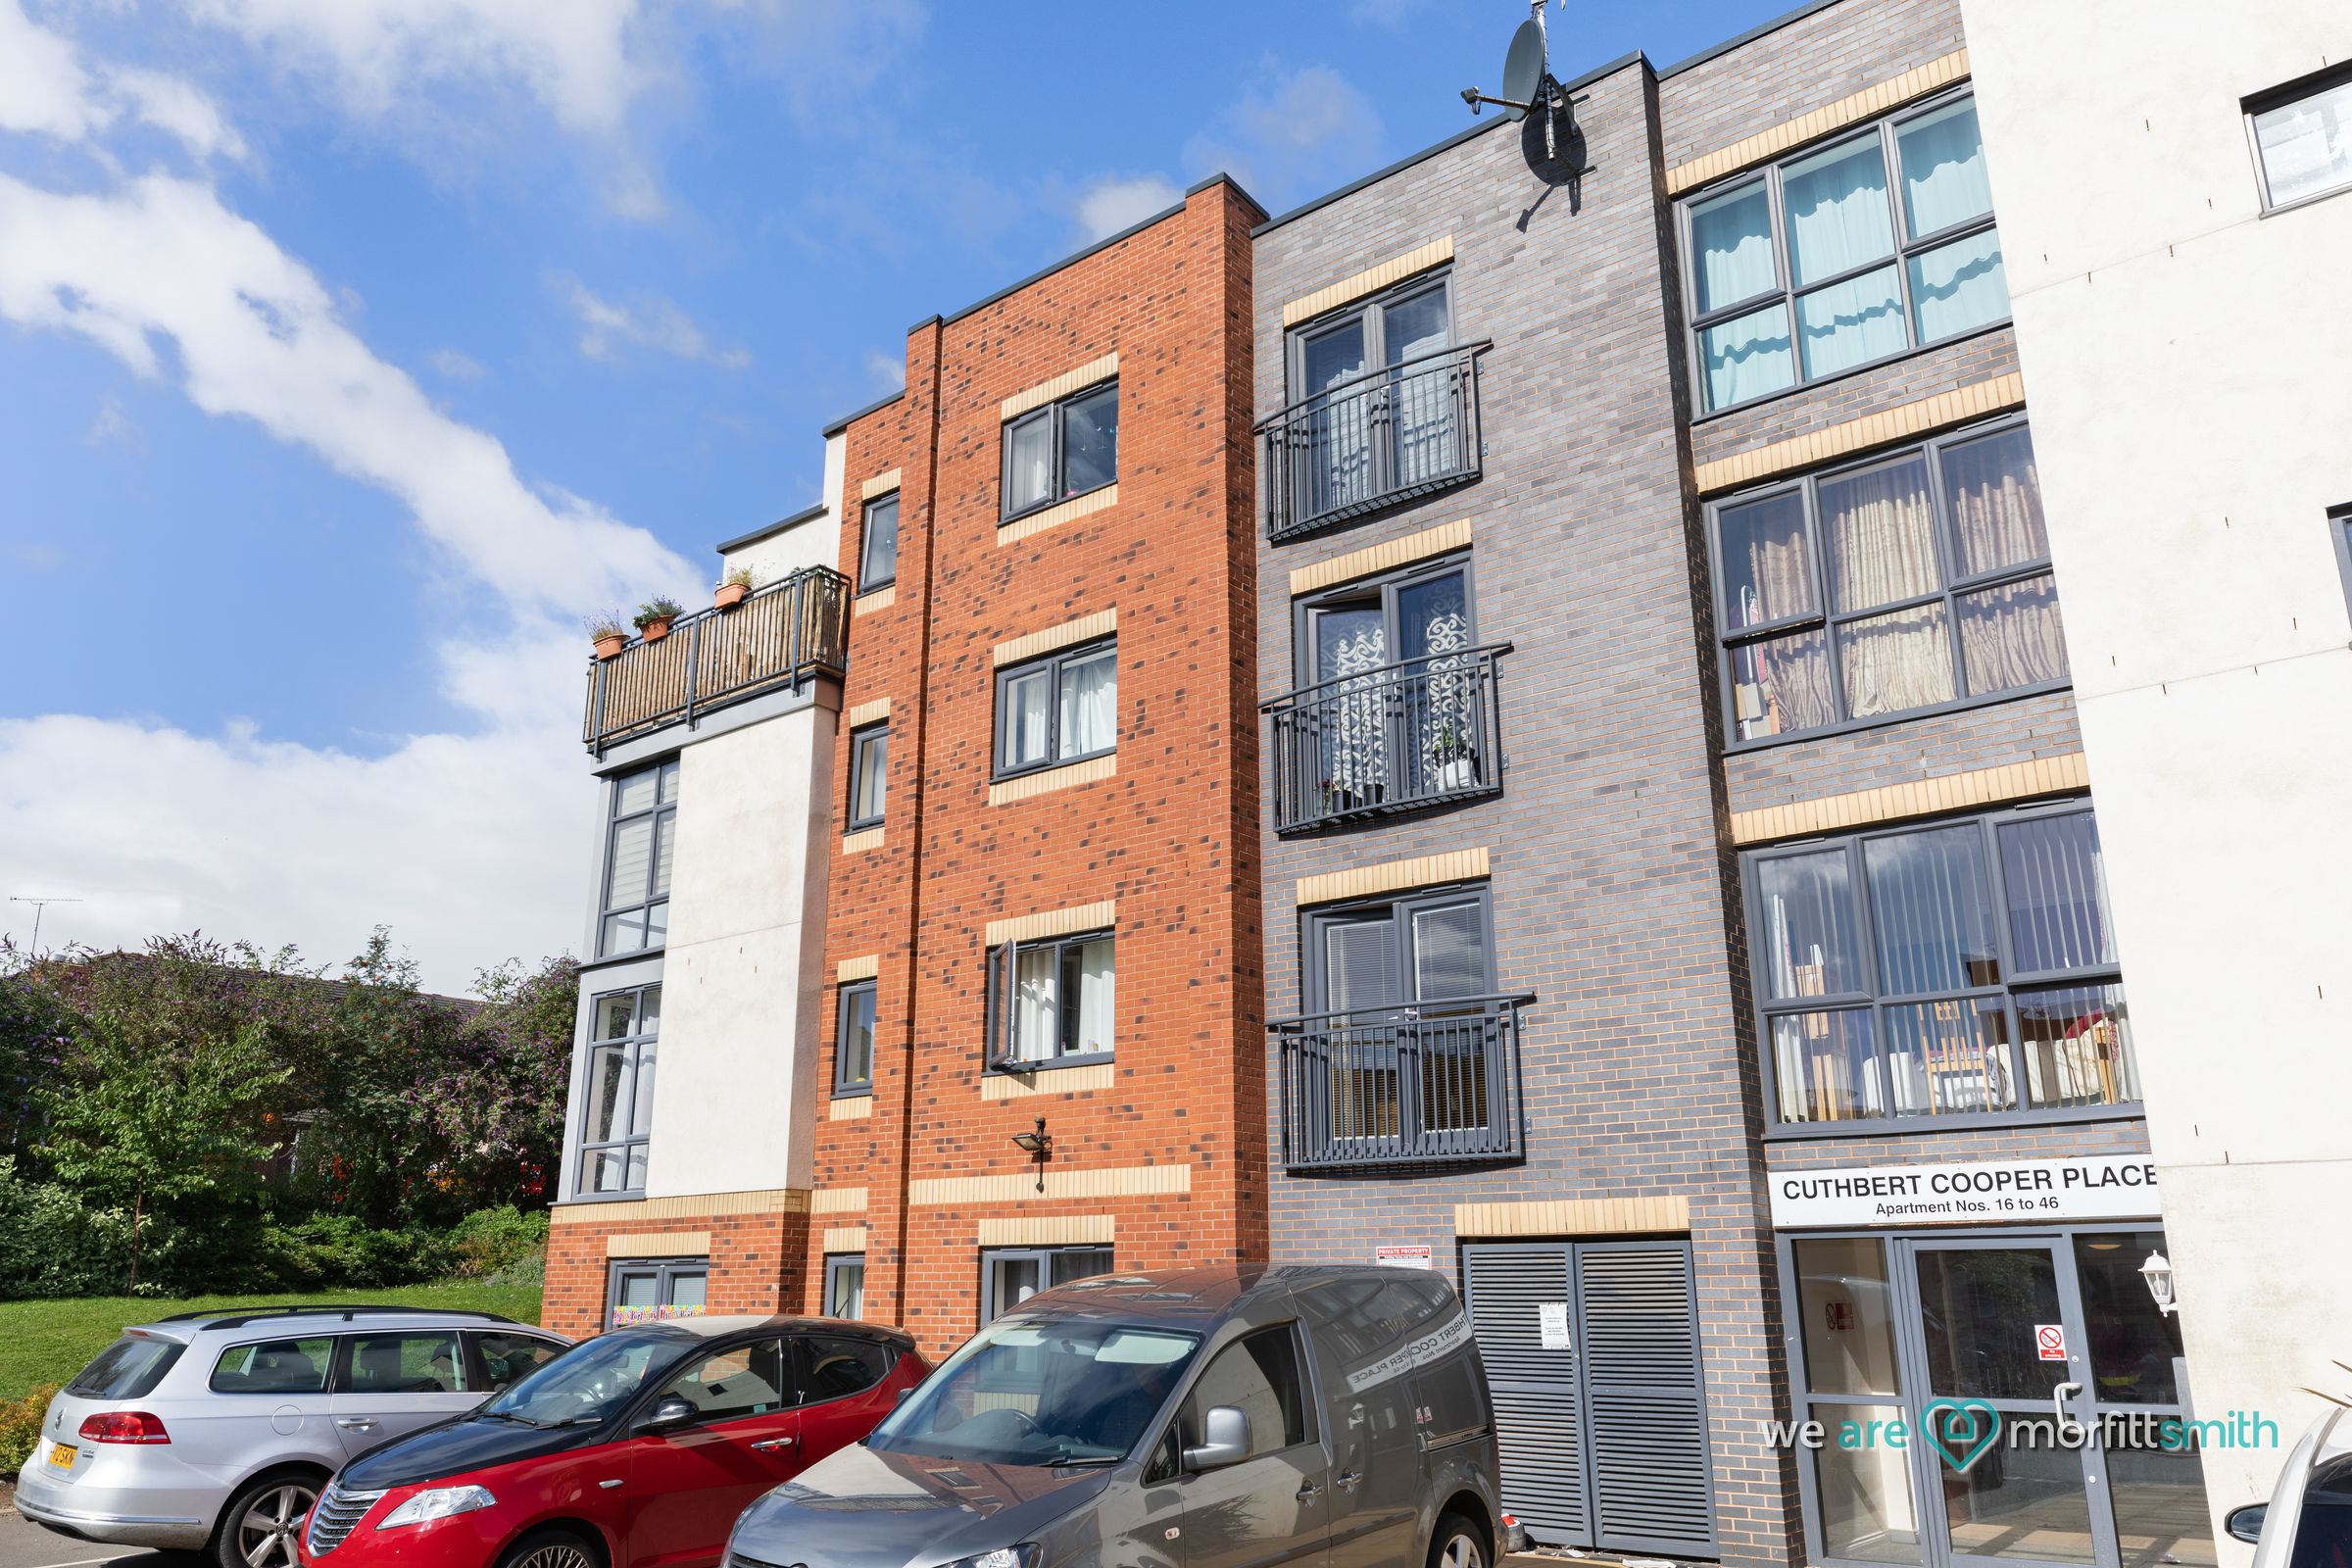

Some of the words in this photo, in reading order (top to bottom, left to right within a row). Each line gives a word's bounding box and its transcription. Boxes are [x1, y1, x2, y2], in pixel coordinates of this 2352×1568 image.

[1783, 1175, 1922, 1200] CUTHBERT
[1931, 1168, 2053, 1194] COOPER
[2062, 1164, 2158, 1189] PLACE
[1876, 1200, 1952, 1217] Apartment
[1956, 1200, 1991, 1212] Nos.
[1995, 1198, 2015, 1211] 16
[2019, 1198, 2034, 1210] to
[2038, 1196, 2059, 1209] 46
